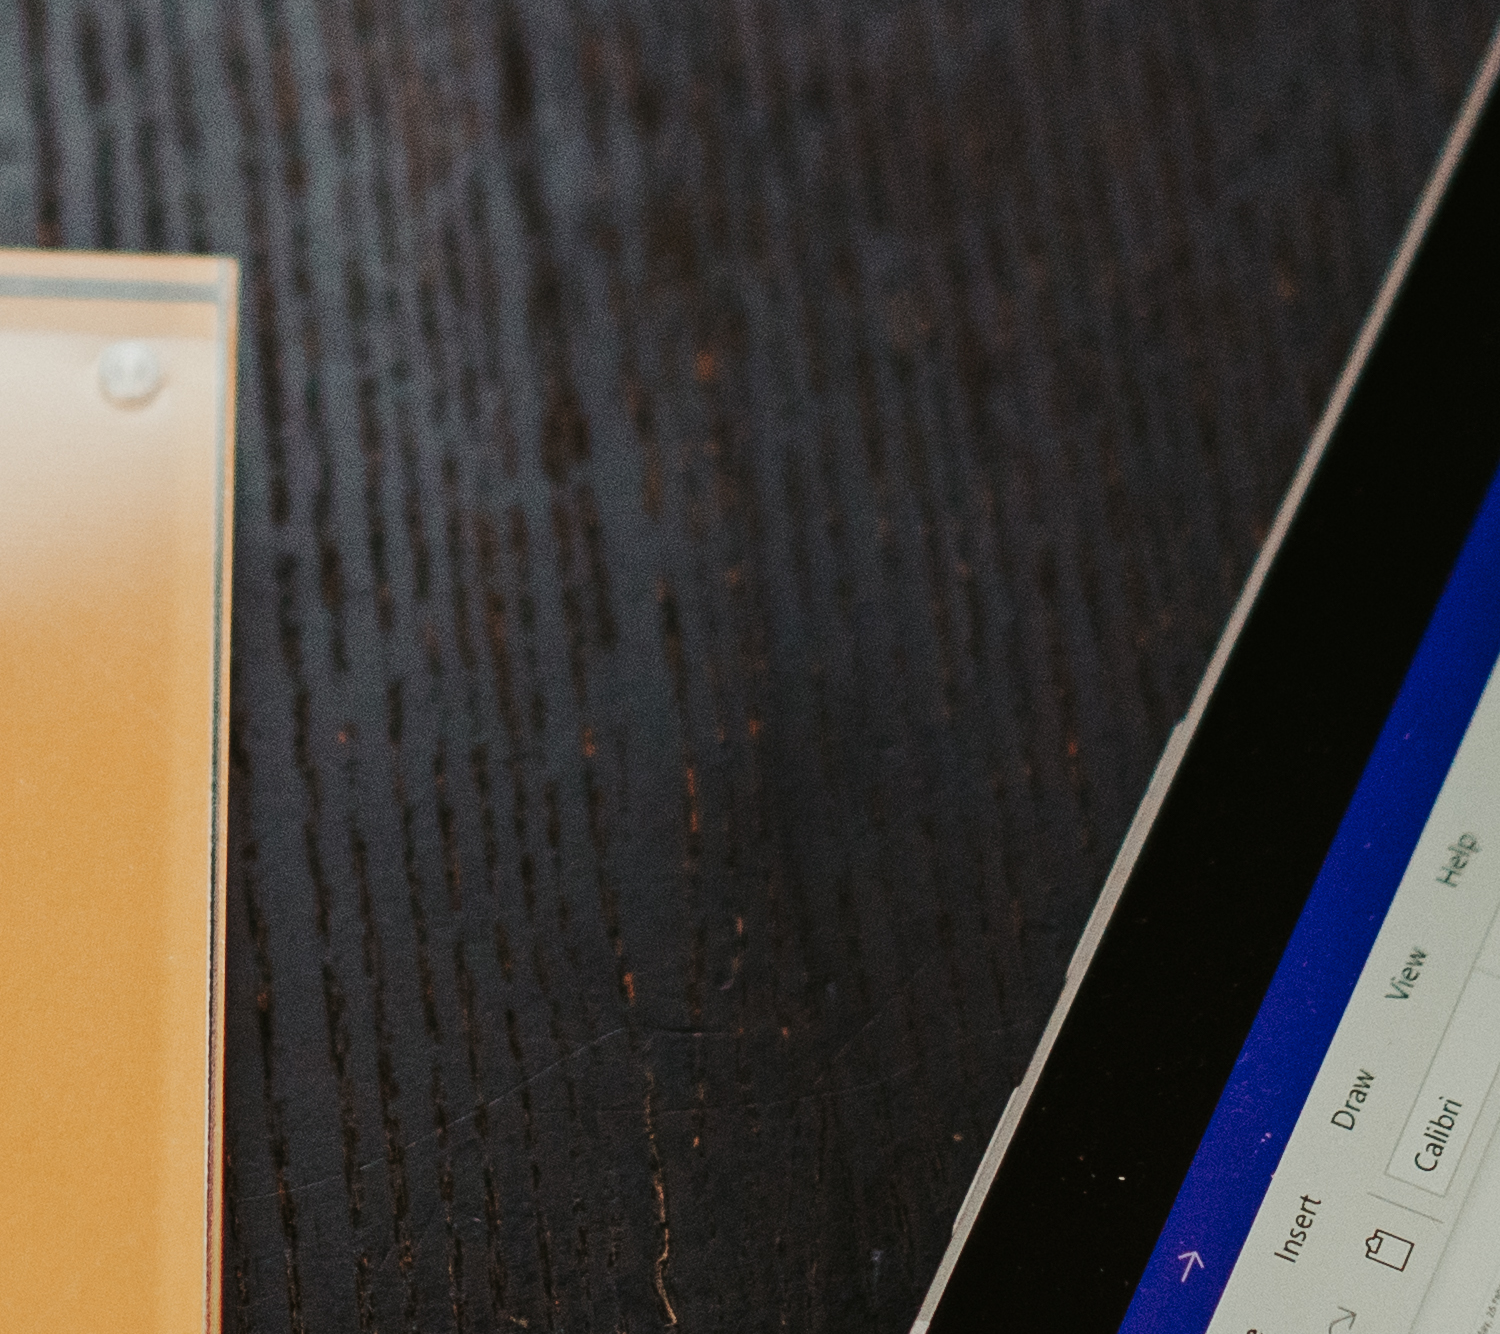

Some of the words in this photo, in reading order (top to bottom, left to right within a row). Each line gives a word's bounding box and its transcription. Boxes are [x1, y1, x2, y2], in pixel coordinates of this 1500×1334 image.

[1437, 833, 1478, 887] Help
[1385, 948, 1427, 1000] View
[1330, 1069, 1374, 1131] Draw
[1413, 1096, 1461, 1172] Calibri
[1274, 1194, 1321, 1263] Insert
